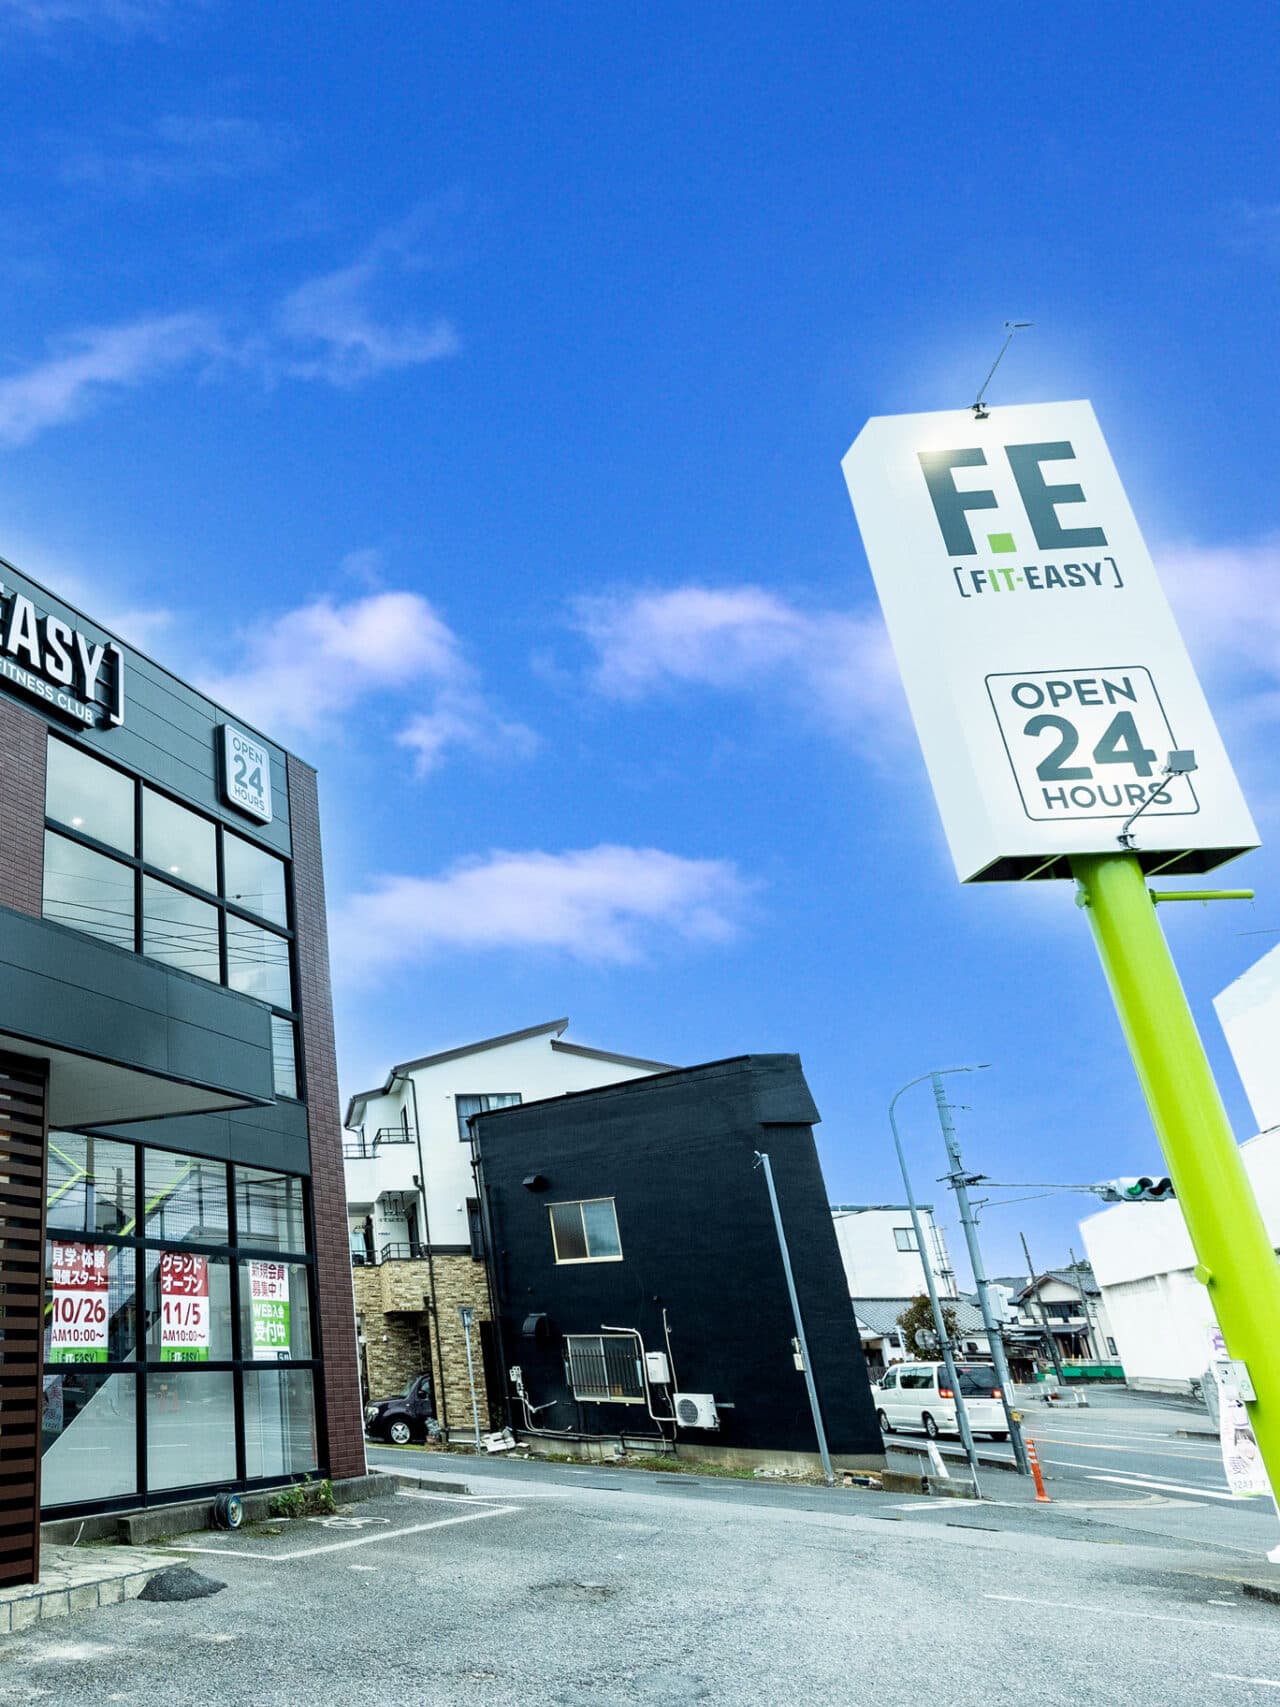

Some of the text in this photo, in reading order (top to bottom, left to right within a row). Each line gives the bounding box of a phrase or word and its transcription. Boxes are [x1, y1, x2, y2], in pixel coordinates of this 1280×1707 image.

[1011, 676, 1138, 709] OPEN
[57, 692, 95, 724] CLUB
[232, 737, 263, 766] OPEN
[1023, 710, 1158, 782] 24
[233, 754, 264, 798] 24
[234, 784, 265, 811] HOURS
[1042, 782, 1173, 810] HOURS
[162, 1254, 203, 1274] グランド
[162, 1273, 203, 1293] オープン
[52, 1297, 106, 1324] 10/26
[163, 1302, 202, 1326] 11/5
[255, 1320, 286, 1343] 受付中
